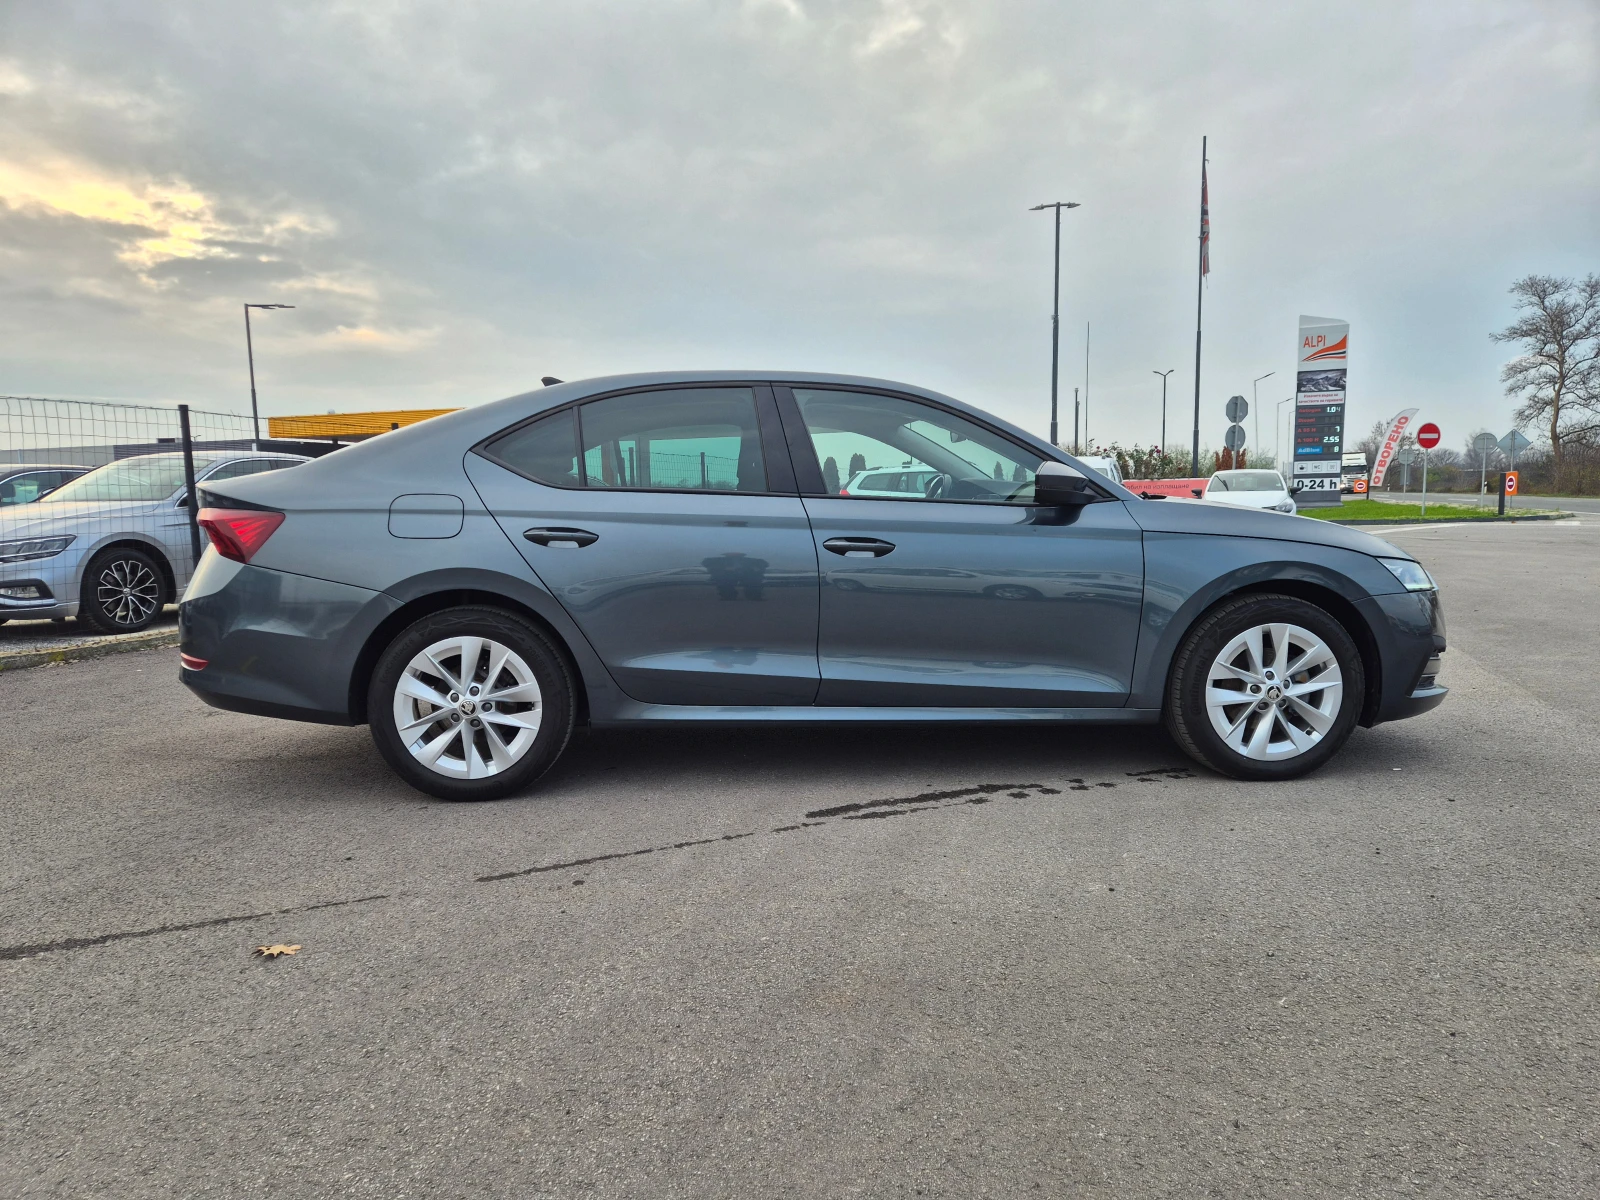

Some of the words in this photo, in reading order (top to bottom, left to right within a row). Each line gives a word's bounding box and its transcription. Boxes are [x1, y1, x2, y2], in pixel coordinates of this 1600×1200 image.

[1303, 335, 1326, 348] ALPI
[1373, 416, 1409, 485] ОТВОРЕНО
[1297, 479, 1325, 490] 0-24
[1330, 479, 1337, 489] h
